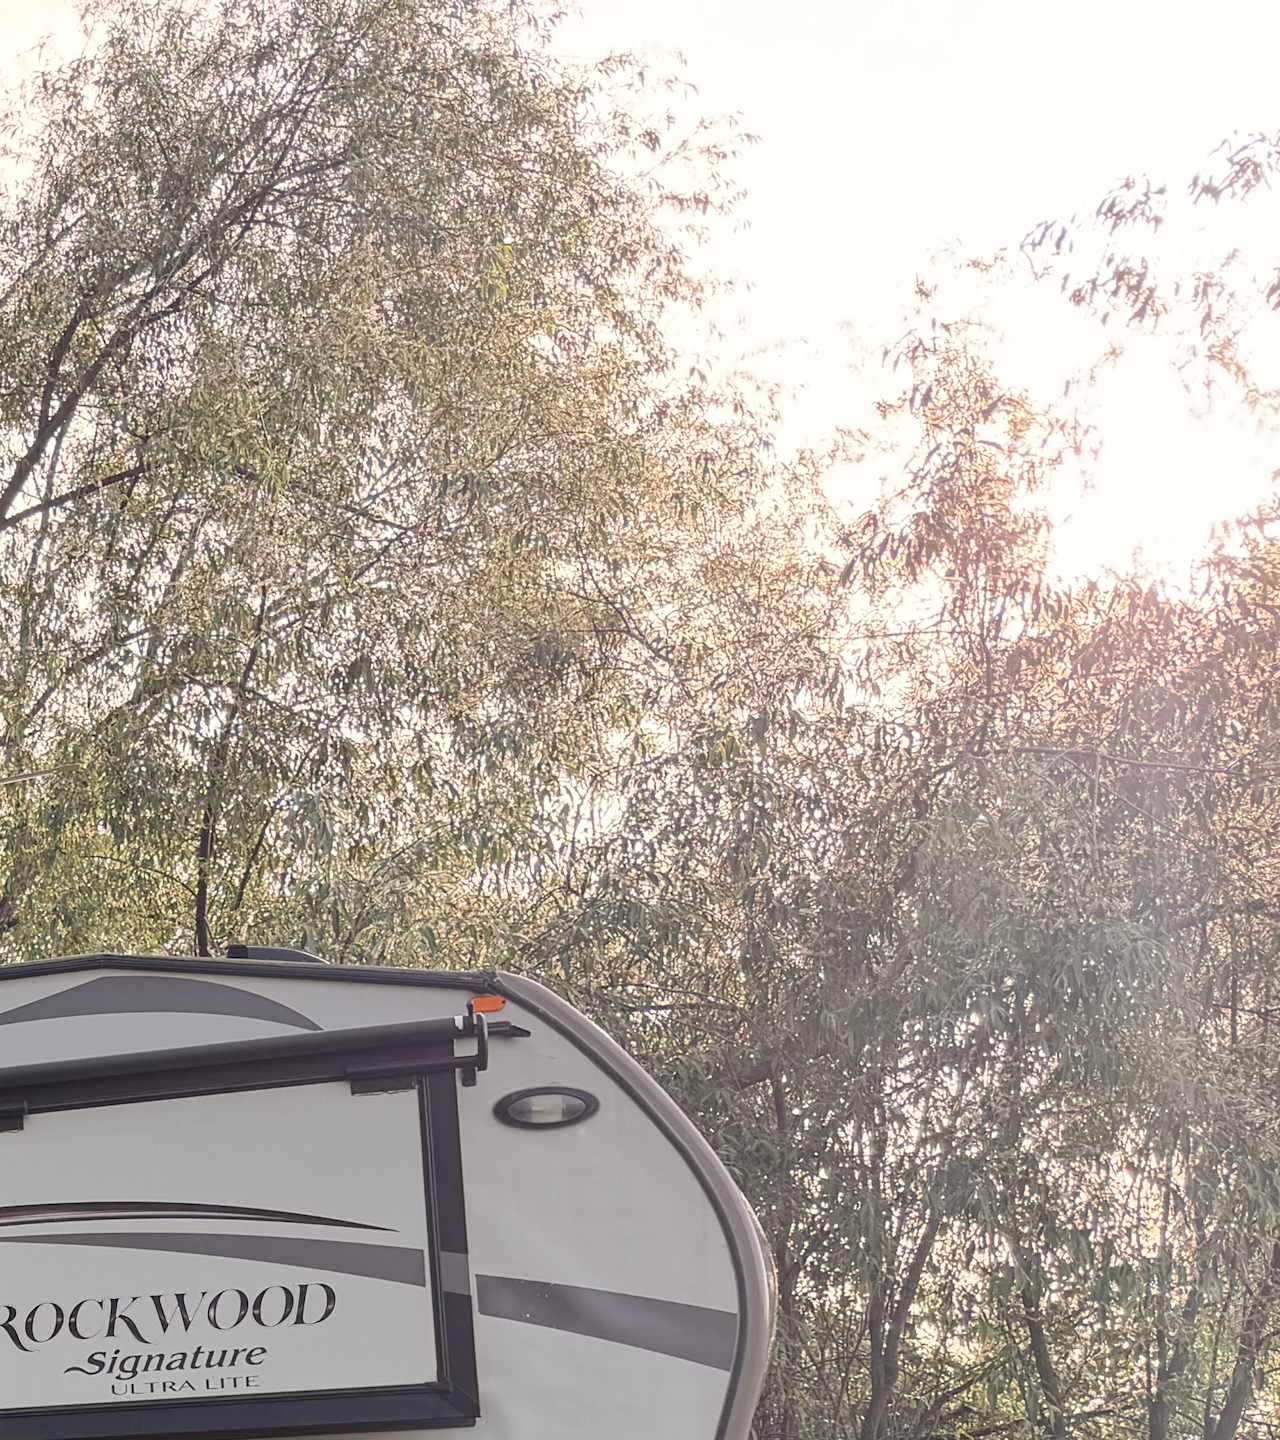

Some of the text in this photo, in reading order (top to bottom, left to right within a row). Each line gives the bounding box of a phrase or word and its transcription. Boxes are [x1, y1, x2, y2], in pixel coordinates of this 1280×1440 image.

[64, 1344, 267, 1381] Signature
[111, 1375, 260, 1396] ULTRA LITE
